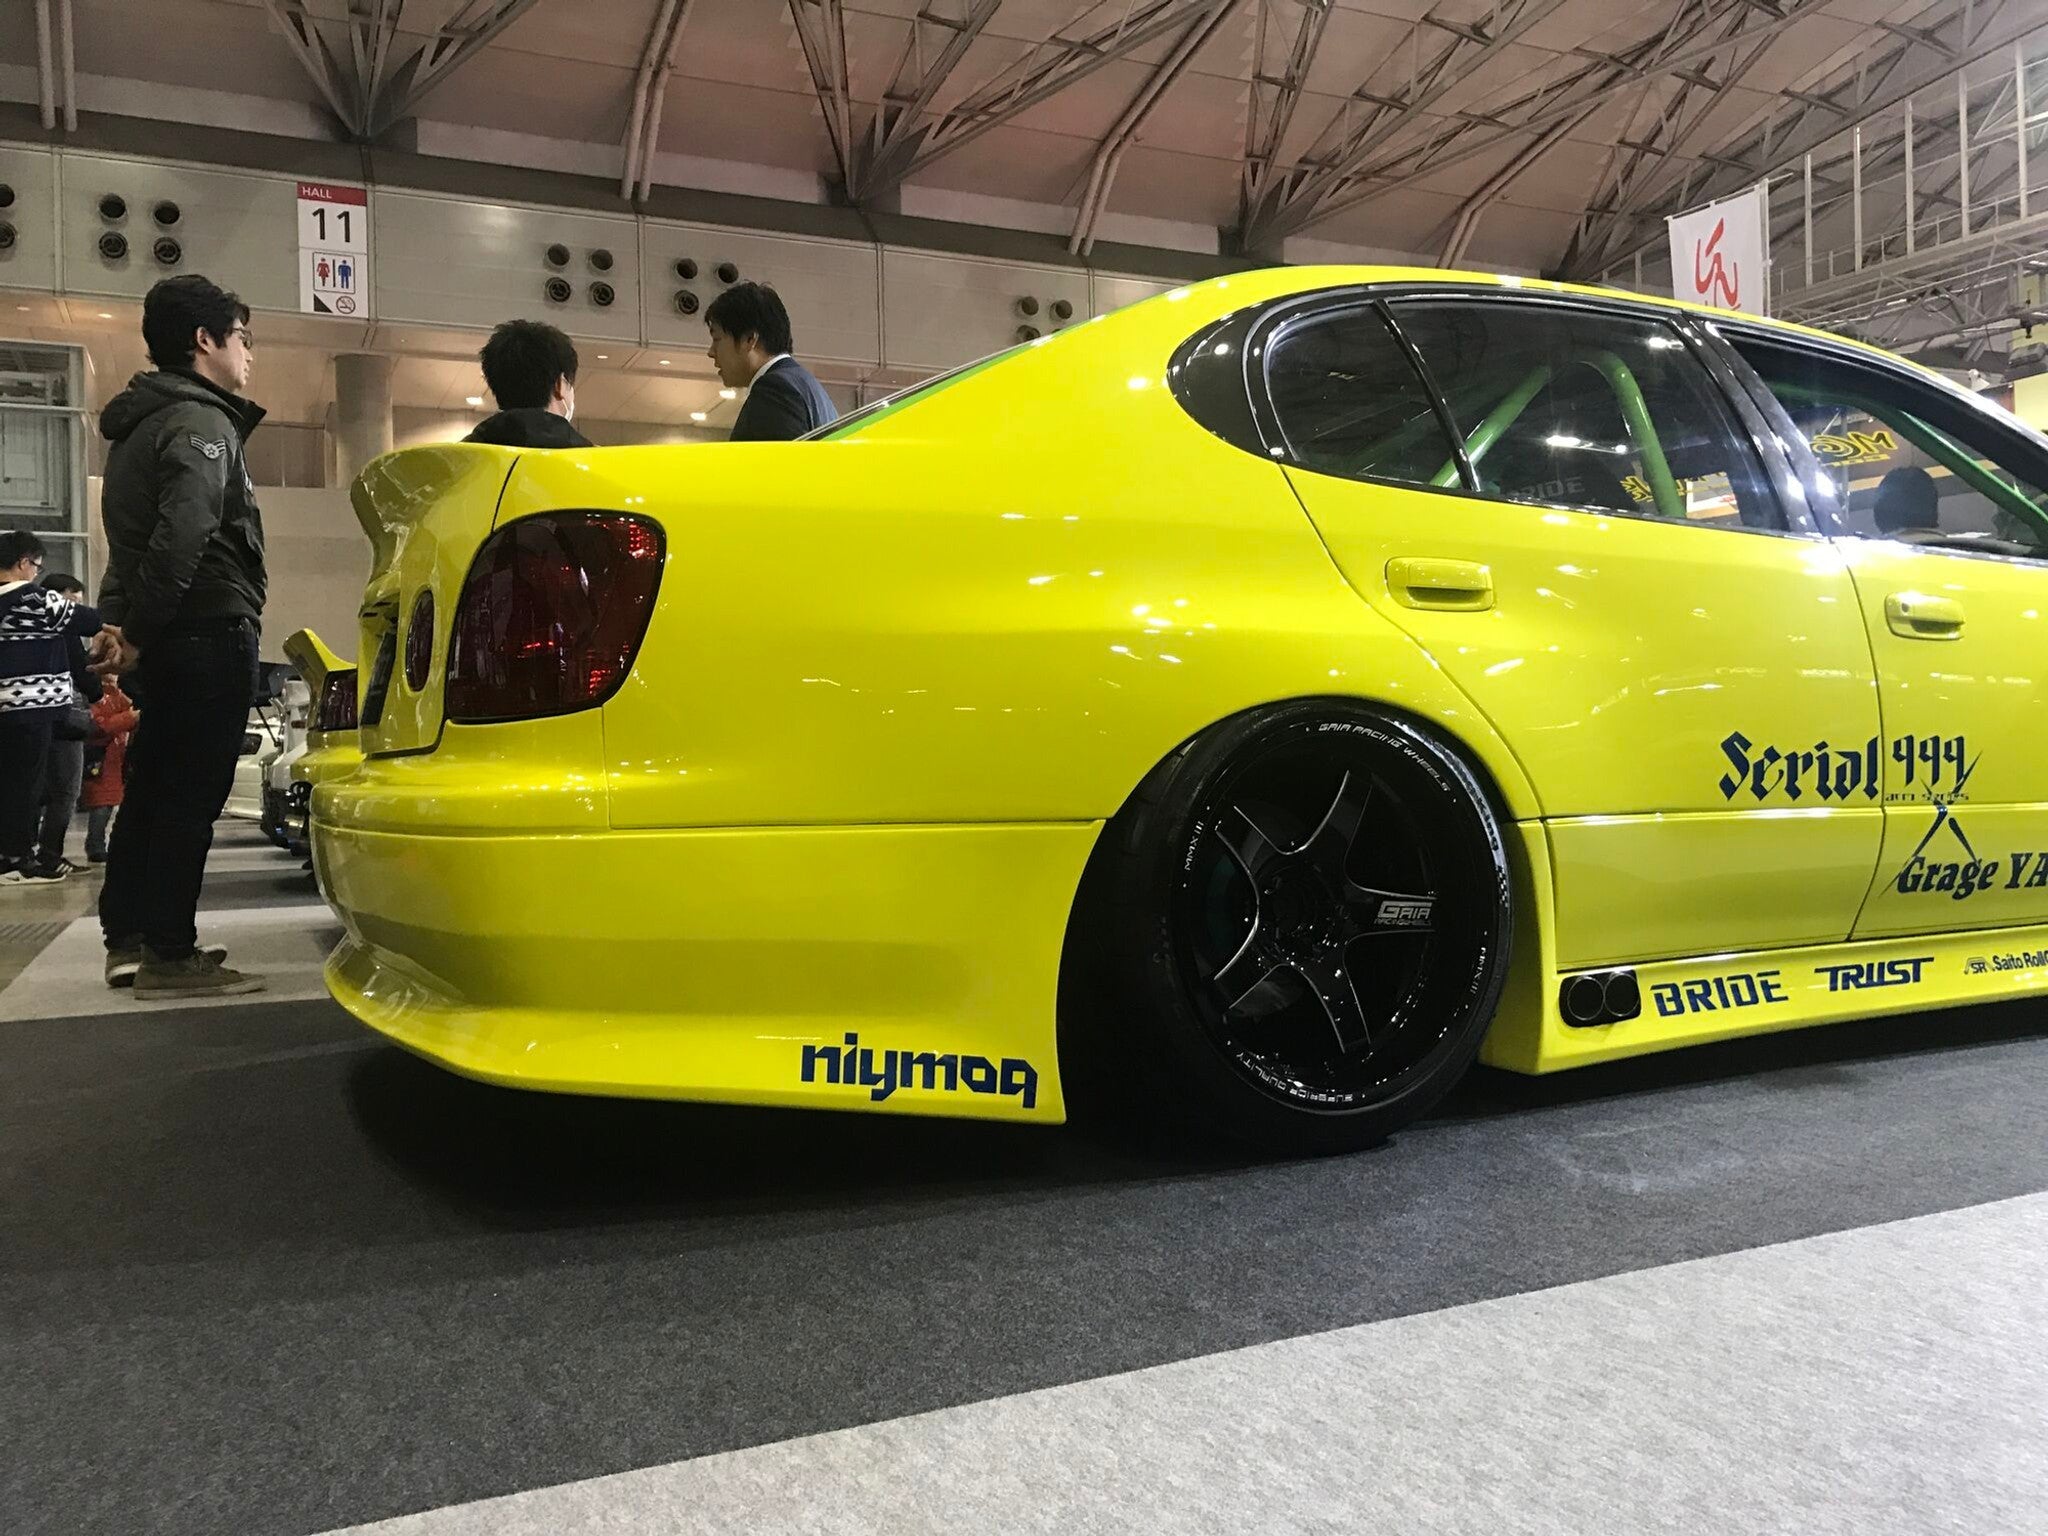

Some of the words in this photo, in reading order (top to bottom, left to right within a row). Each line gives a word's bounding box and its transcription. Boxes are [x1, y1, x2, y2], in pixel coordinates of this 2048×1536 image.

[302, 186, 332, 199] HALL
[312, 207, 351, 243] 11
[1318, 722, 1352, 732] GAIA
[1352, 725, 1402, 749] RACING
[1403, 746, 1452, 792] WHEELS
[1377, 900, 1433, 919] GAIA
[1814, 956, 1935, 992] TRUST
[1992, 953, 2024, 972] Saito
[1649, 970, 1789, 1018] BRIDE
[1235, 1051, 1288, 1091] QUALITY
